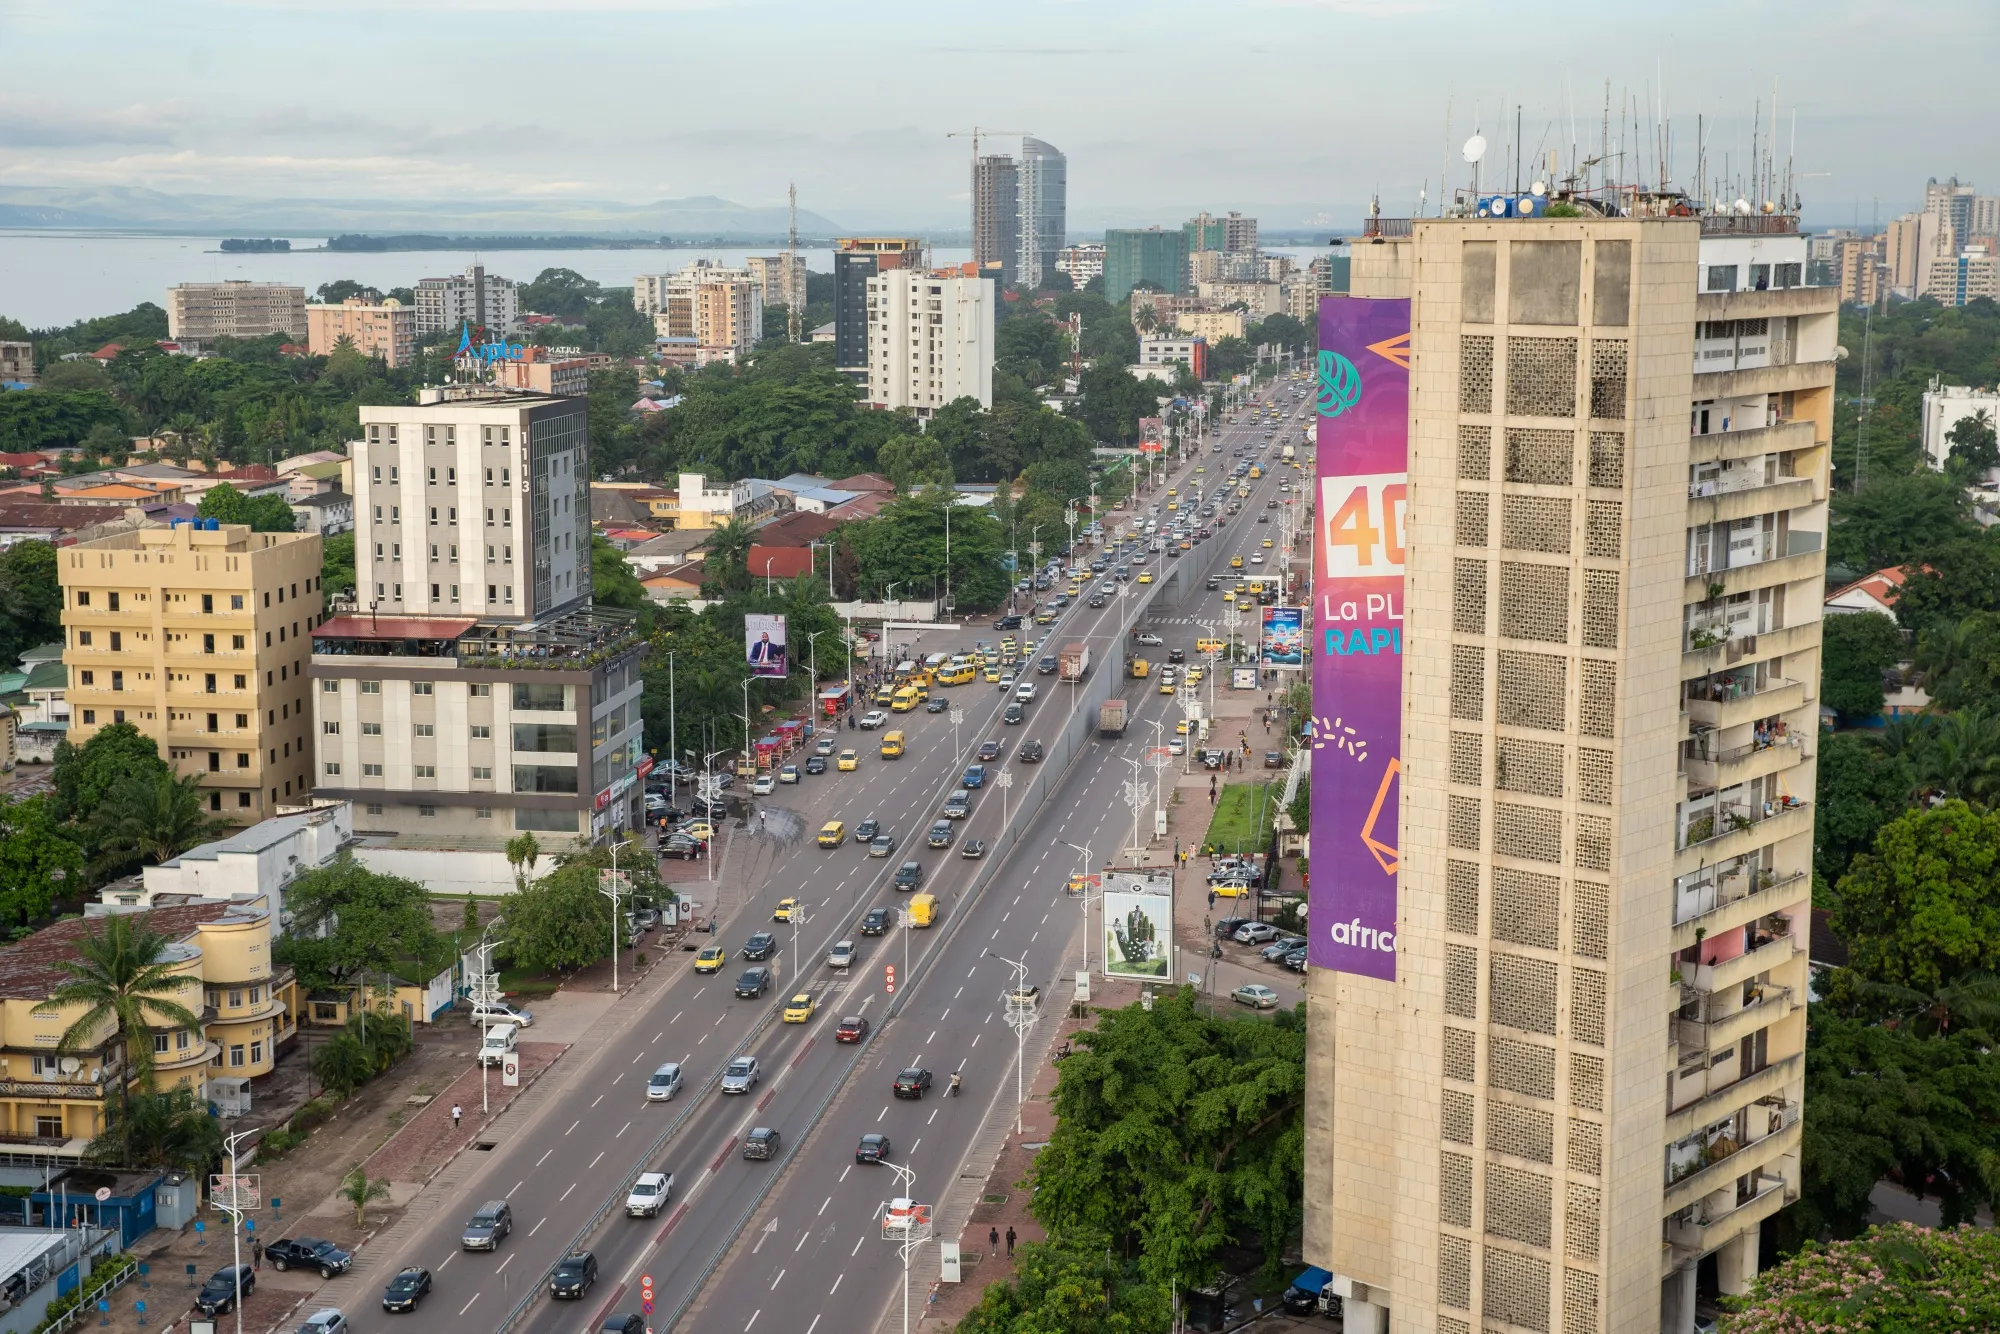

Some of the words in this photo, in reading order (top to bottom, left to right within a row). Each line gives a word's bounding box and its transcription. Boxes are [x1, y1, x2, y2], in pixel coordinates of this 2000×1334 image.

[521, 431, 530, 493] 1113
[1324, 595, 1357, 621] La
[1331, 918, 1397, 953] afric
